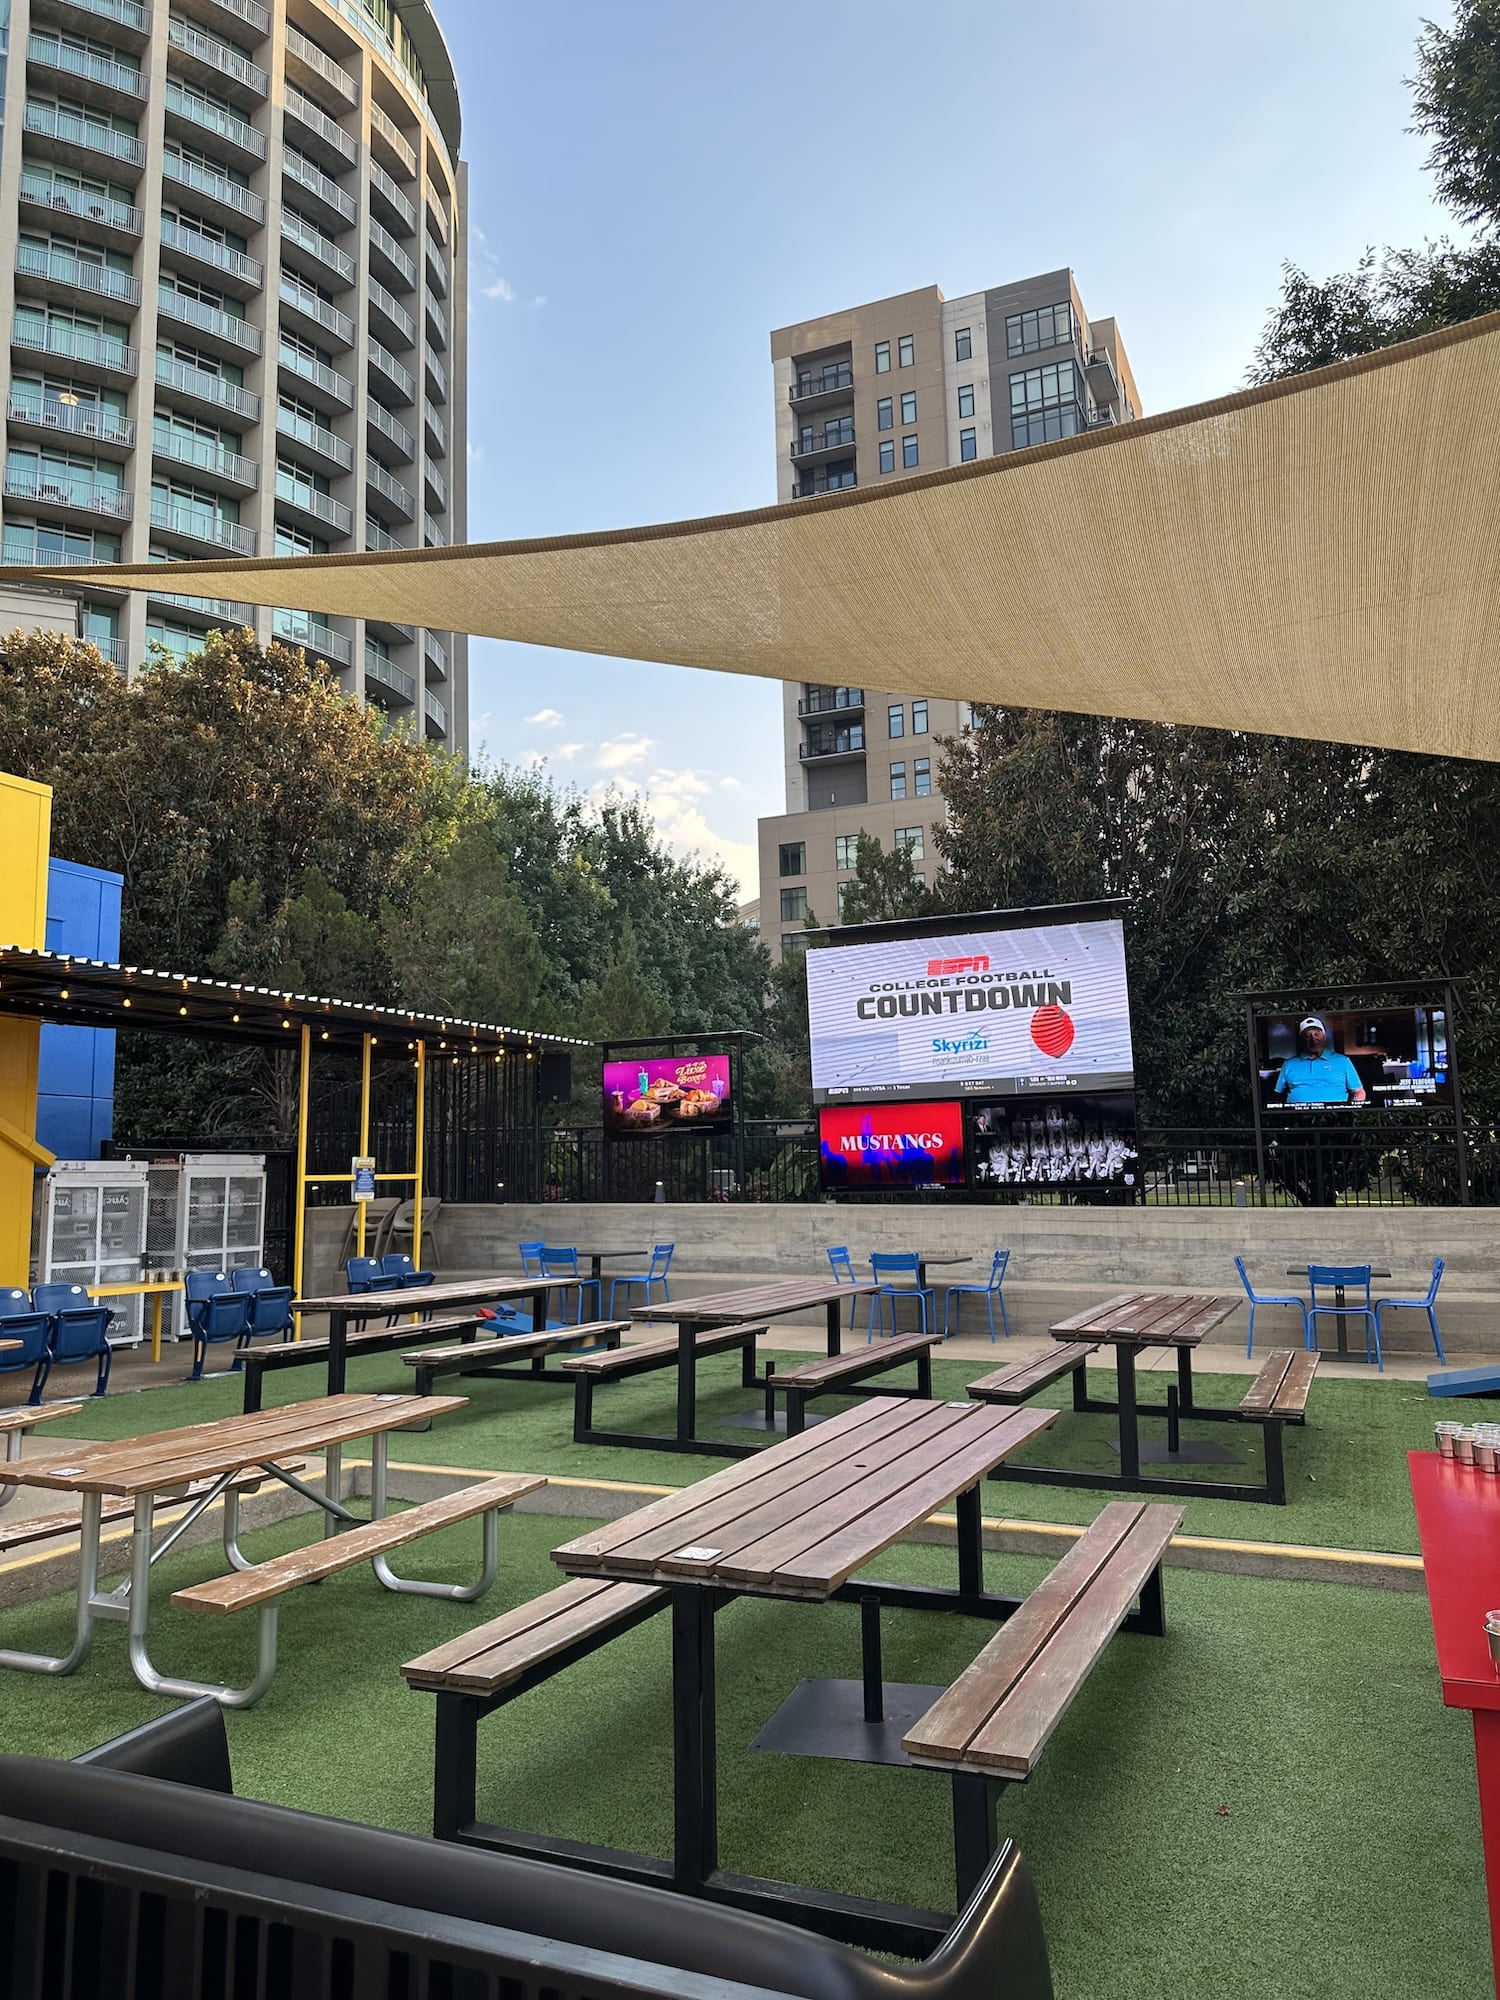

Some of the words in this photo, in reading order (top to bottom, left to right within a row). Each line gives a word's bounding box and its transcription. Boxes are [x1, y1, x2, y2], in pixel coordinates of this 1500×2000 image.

[927, 955, 990, 976] ESPN
[869, 977, 950, 993] COLLEGE
[956, 969, 1055, 986] FOOTBALL
[856, 980, 1072, 1020] COUNTDOWN
[840, 1133, 944, 1152] MUSTANGS
